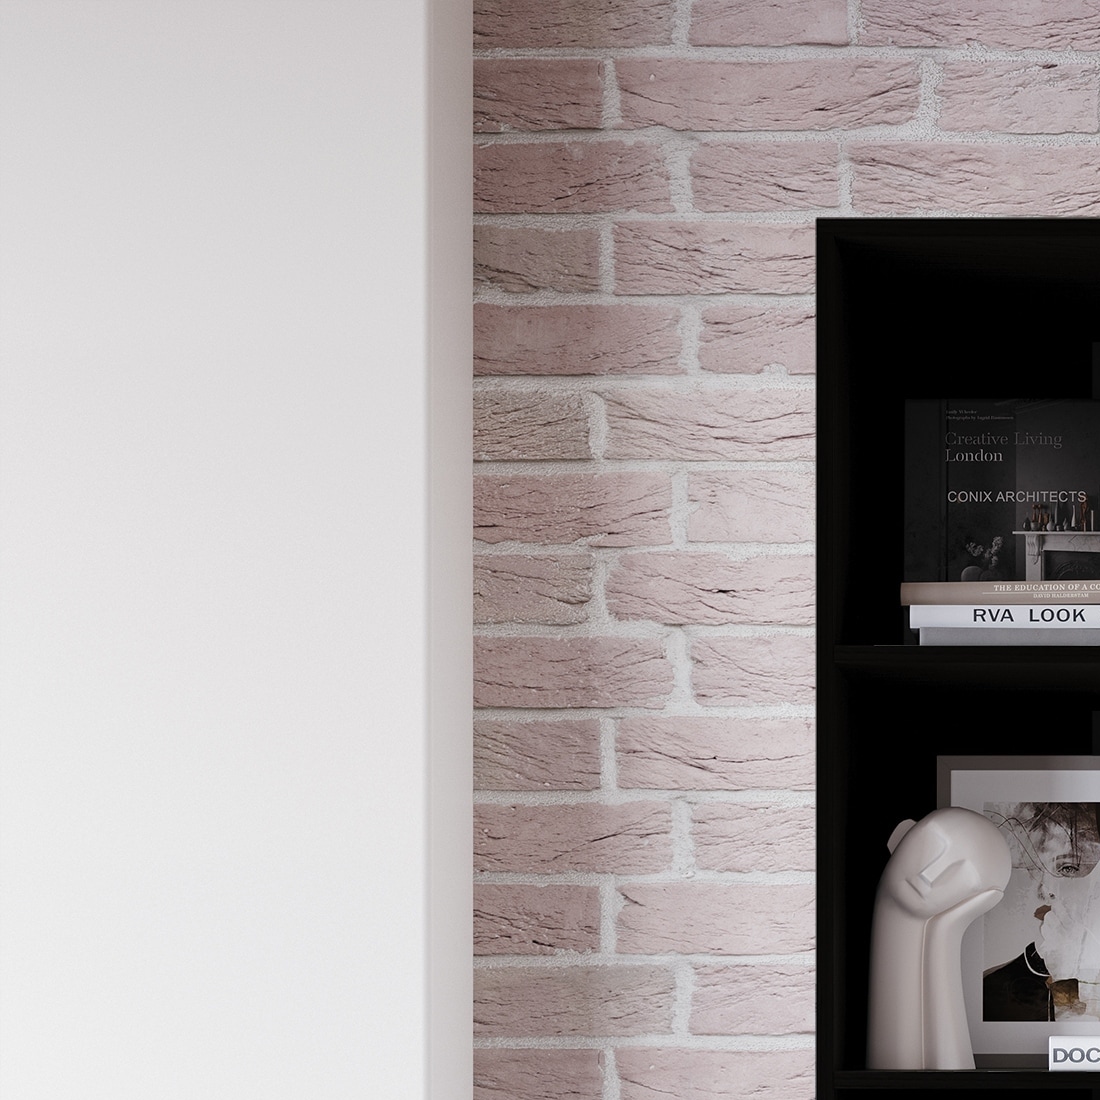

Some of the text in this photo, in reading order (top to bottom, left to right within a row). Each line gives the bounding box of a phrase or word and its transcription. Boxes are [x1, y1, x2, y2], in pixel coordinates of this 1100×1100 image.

[945, 432, 1063, 449] Creative Living
[945, 448, 1004, 462] London
[947, 490, 1088, 503] CONIX ARCHITECTS
[1014, 583, 1066, 592] EDUCATION
[1067, 583, 1080, 591] OF
[1081, 583, 1088, 591] A
[973, 608, 1015, 623] RVA
[1029, 608, 1086, 623] LOOK
